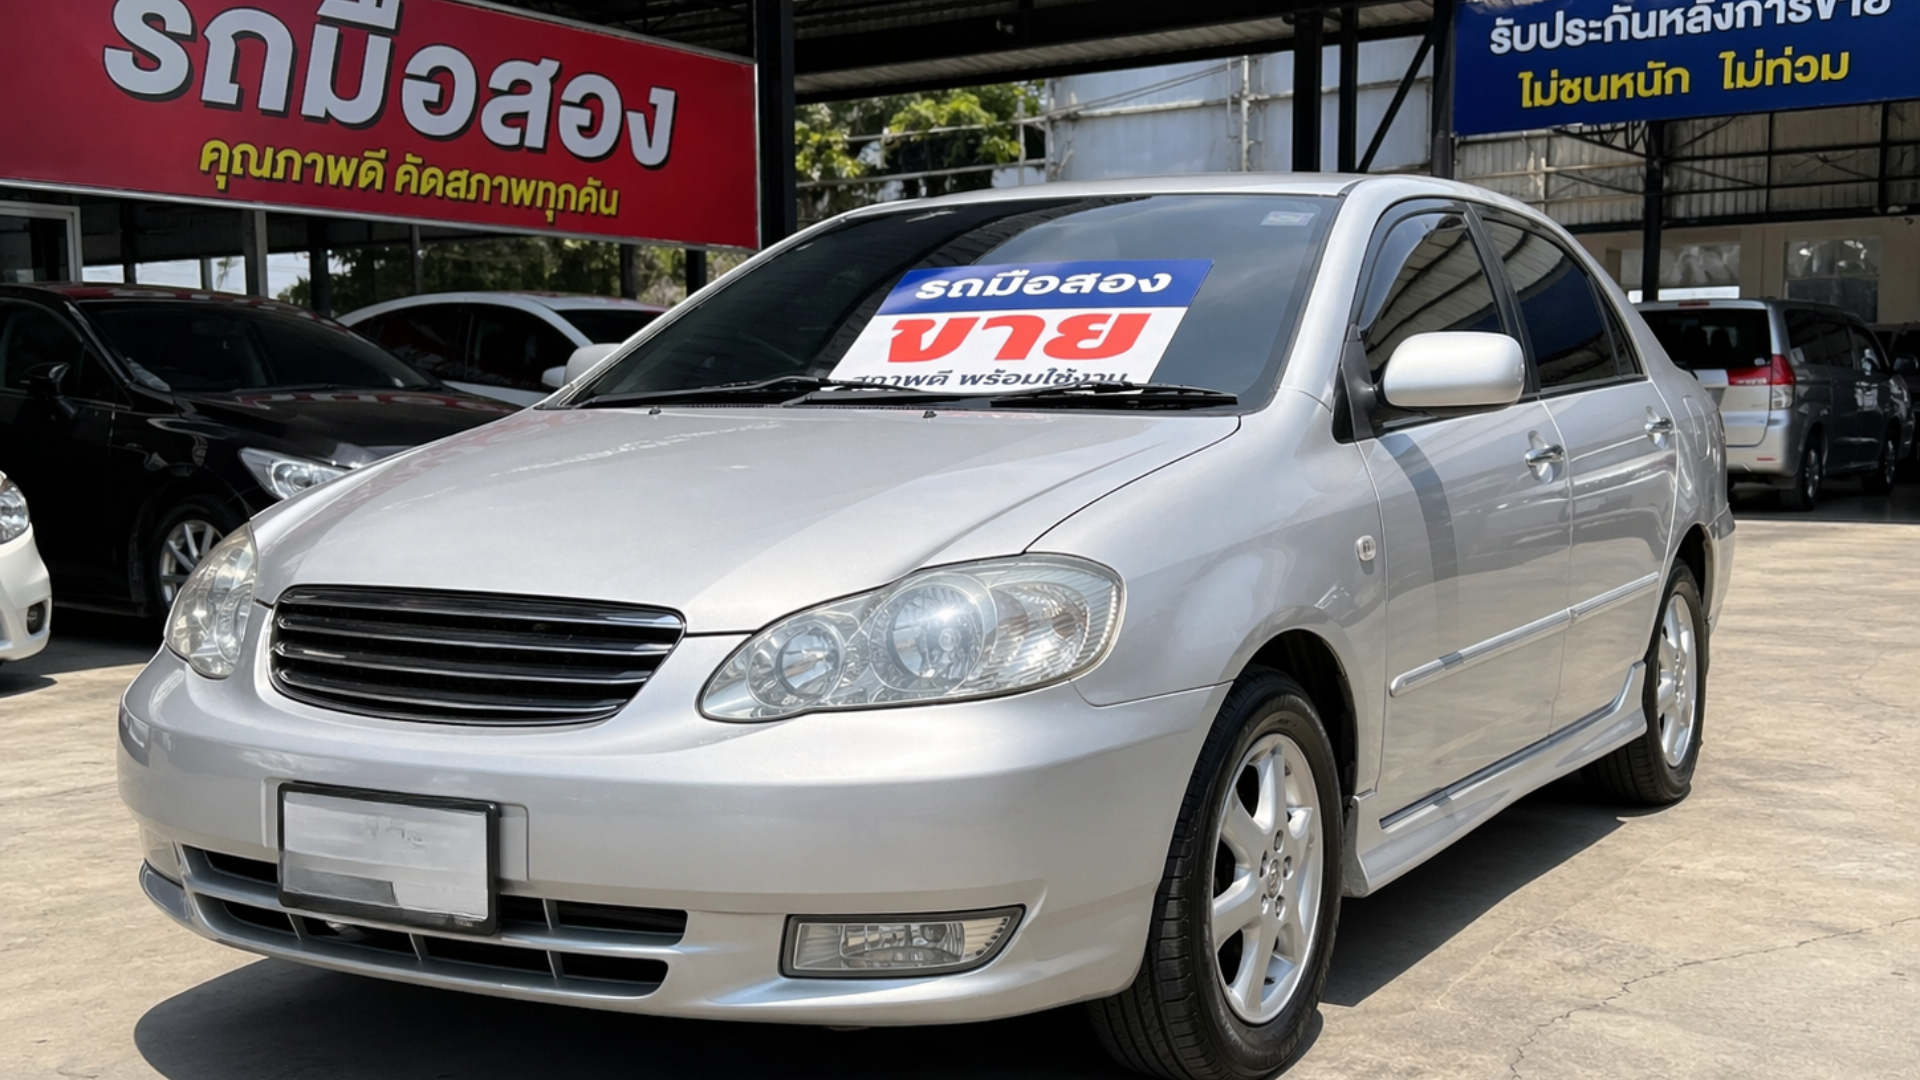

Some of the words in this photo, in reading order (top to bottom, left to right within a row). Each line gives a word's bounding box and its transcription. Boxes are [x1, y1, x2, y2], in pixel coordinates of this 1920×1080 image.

[104, 0, 676, 166] รถมือสอง
[1518, 61, 1690, 108] ไม่ชนหนัก
[1718, 46, 1849, 90] ไม่ท่วม
[200, 139, 387, 190] คุณภาพดี
[394, 153, 619, 223] คัดสภาพทุกคัน
[915, 269, 1172, 300] รถมือสอง
[888, 313, 1152, 363] ขาย
